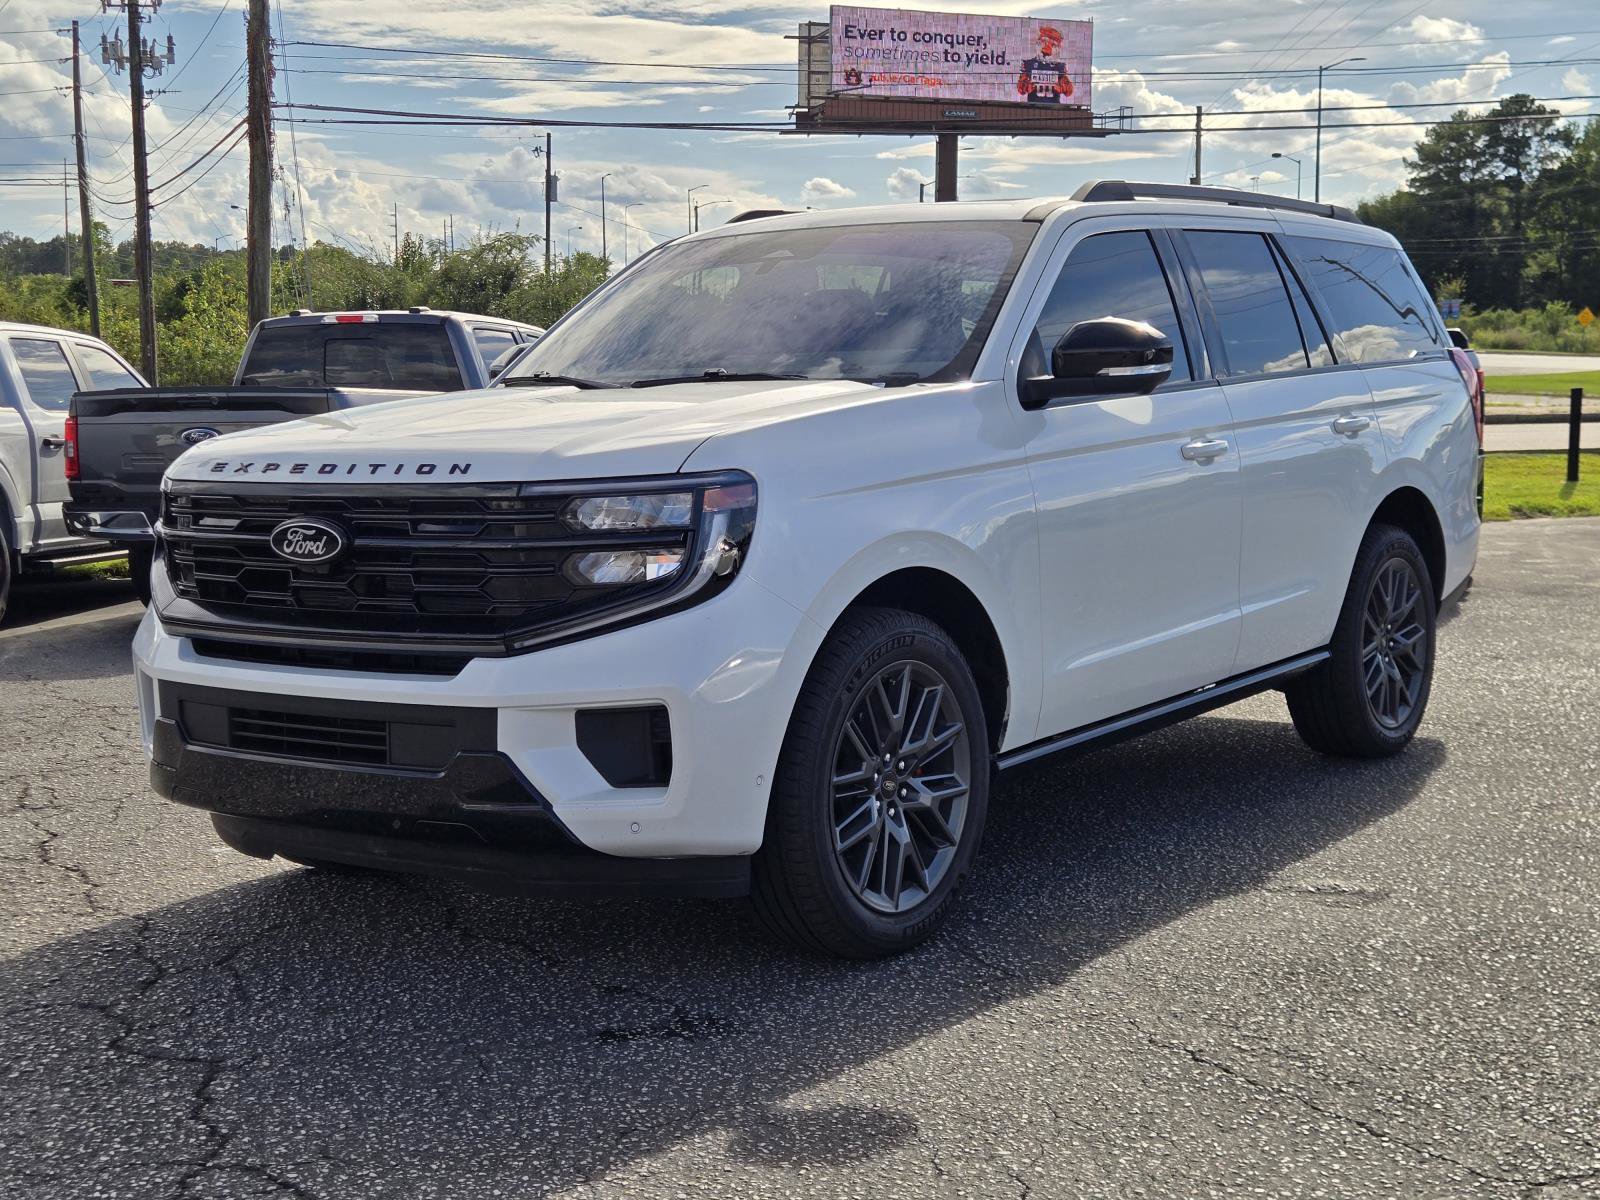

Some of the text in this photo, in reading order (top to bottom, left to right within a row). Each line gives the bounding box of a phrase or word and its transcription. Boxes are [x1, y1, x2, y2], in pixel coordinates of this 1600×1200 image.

[844, 24, 988, 50] Ever to conquer,
[843, 44, 1011, 67] sometimes to yield.
[211, 462, 472, 475] EXPEDITION
[283, 527, 327, 555] Ford
